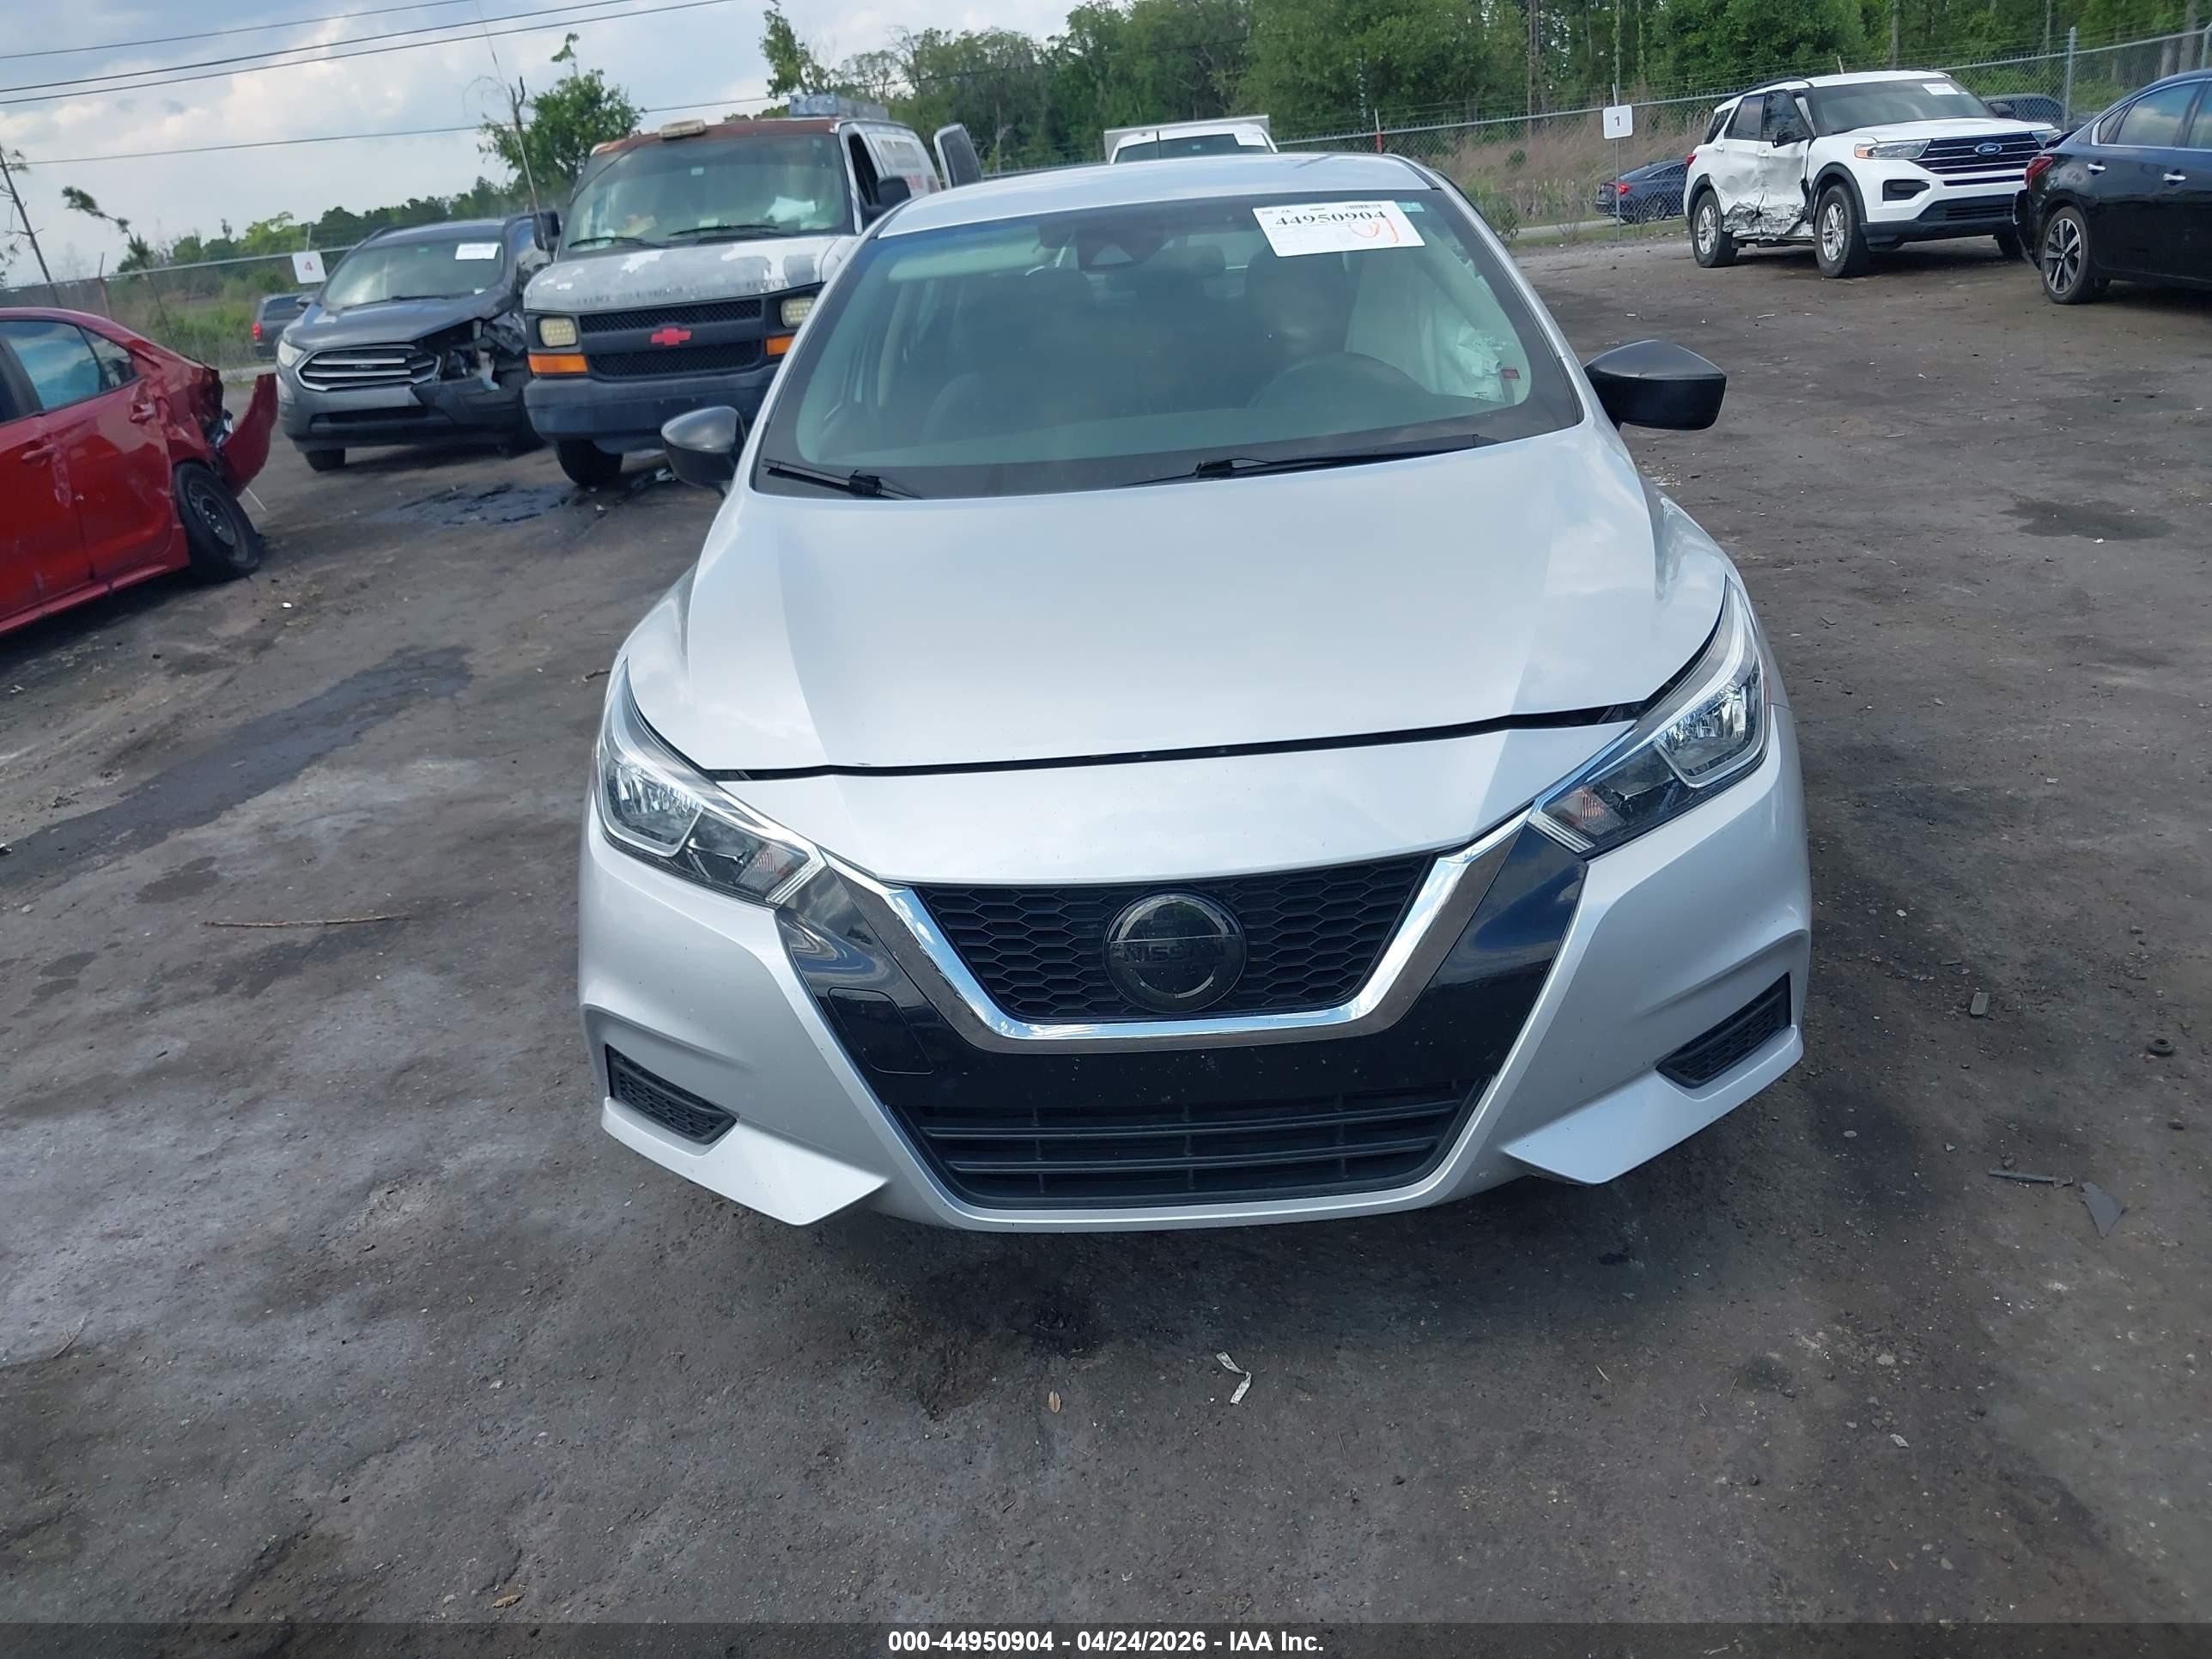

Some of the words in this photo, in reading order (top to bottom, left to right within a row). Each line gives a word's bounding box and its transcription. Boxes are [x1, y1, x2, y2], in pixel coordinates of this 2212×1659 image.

[1614, 115, 1621, 127] 1
[1275, 210, 1388, 227] 44950904
[304, 260, 314, 272] 4
